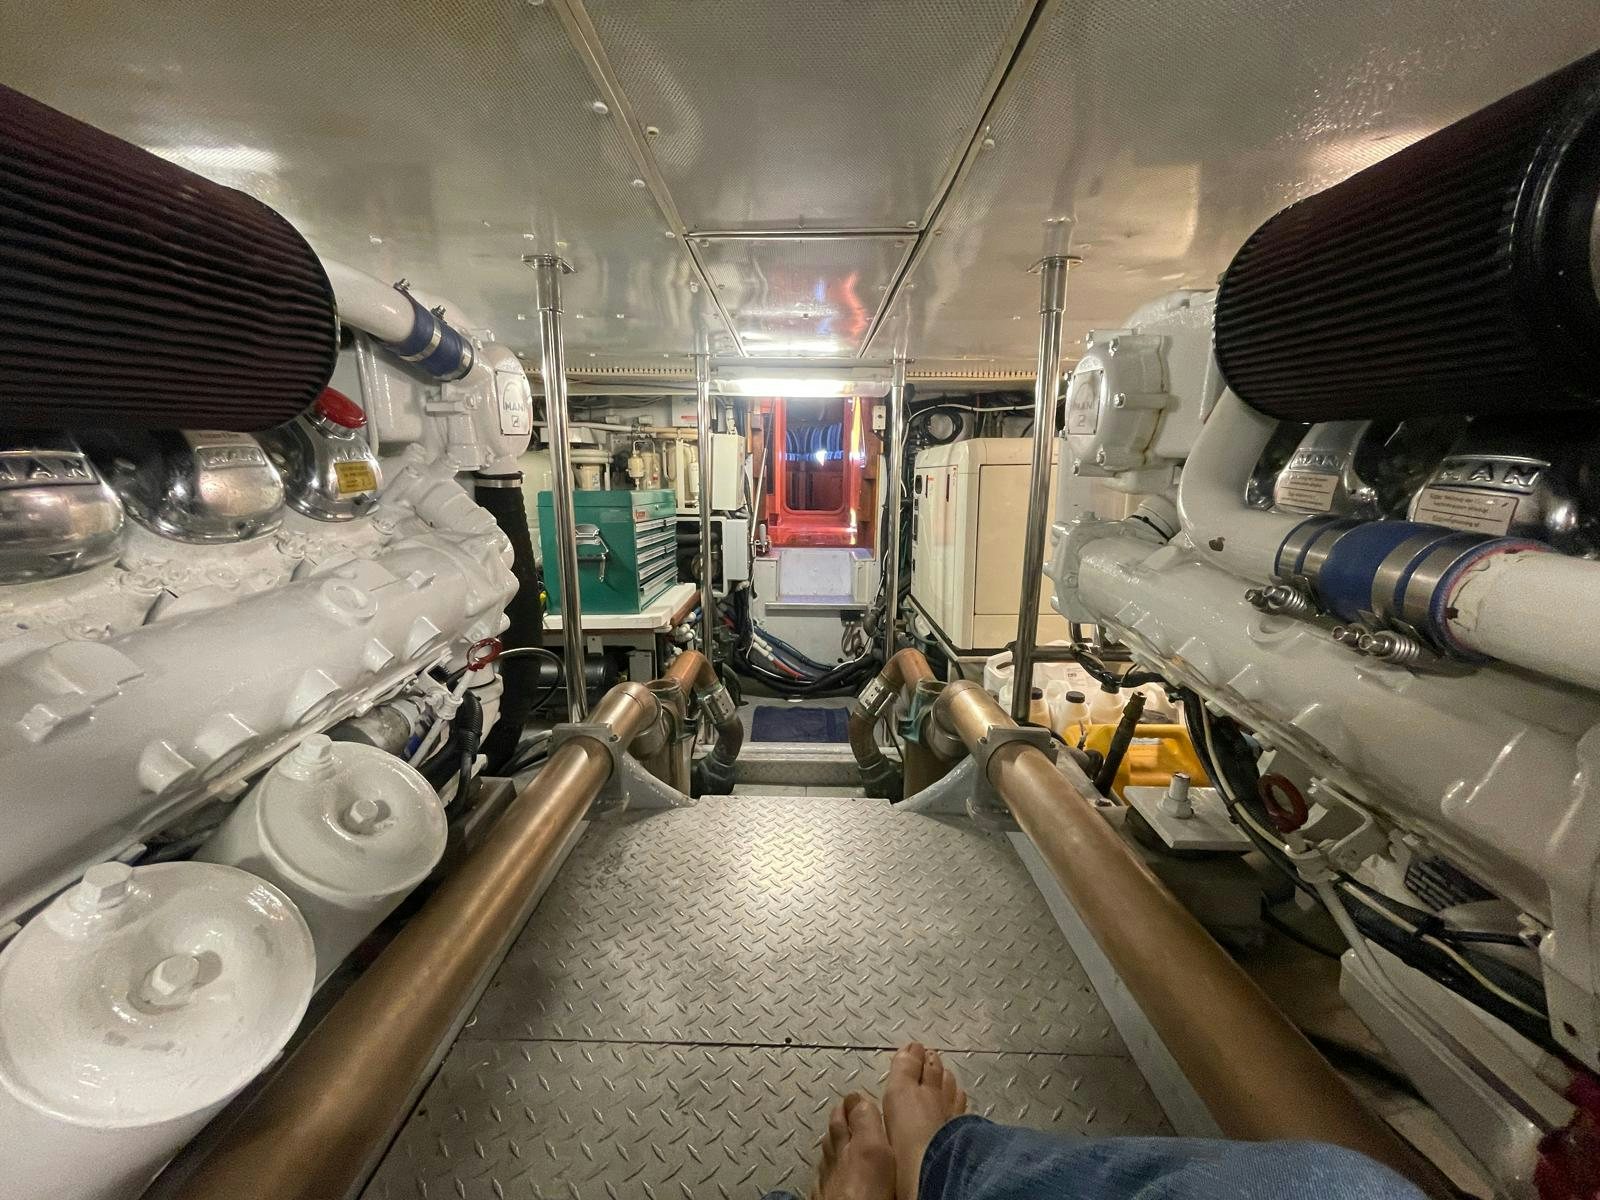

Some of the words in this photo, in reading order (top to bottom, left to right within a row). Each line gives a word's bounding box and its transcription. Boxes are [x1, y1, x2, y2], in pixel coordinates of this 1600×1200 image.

[504, 401, 525, 411] MAN
[511, 415, 520, 428] 2
[1076, 414, 1086, 427] 2
[1440, 461, 1540, 488] MAN
